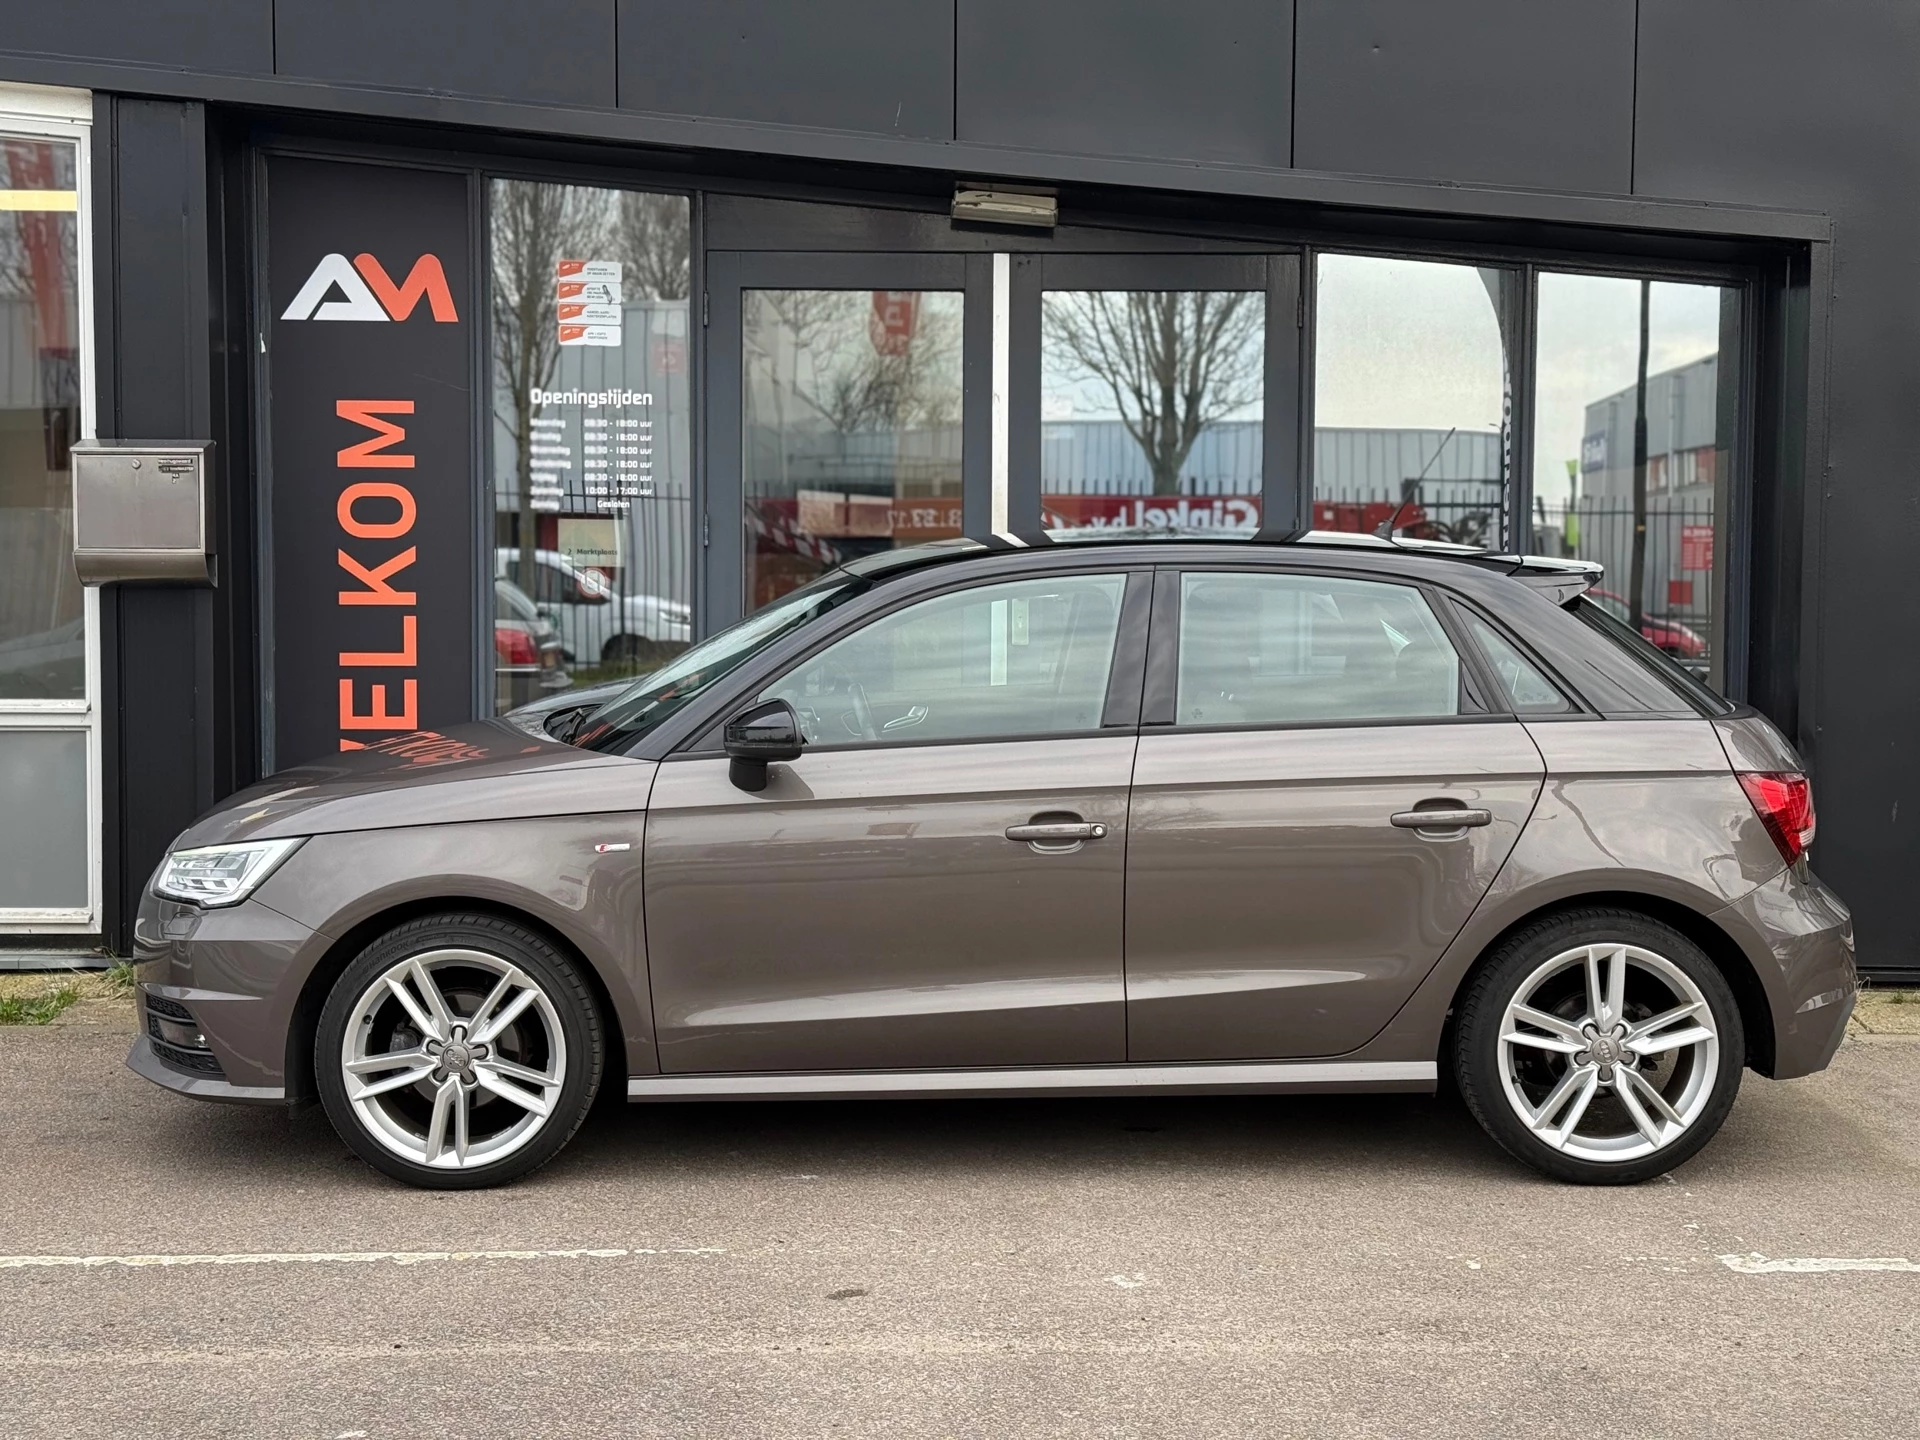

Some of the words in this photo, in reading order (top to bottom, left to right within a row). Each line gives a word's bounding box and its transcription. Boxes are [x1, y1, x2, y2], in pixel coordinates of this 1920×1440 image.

[530, 388, 653, 408] Openingstijden
[616, 419, 638, 428] 18:00
[616, 433, 638, 441] 18:00
[616, 446, 638, 455] 18:00
[616, 460, 638, 468] 18:00
[616, 473, 638, 481] 18:00
[586, 486, 608, 495] 10:00
[616, 487, 638, 495] 17:00
[597, 500, 630, 509] Gesloten
[576, 548, 618, 556] Marktplaats
[336, 400, 418, 751] ELKOM
